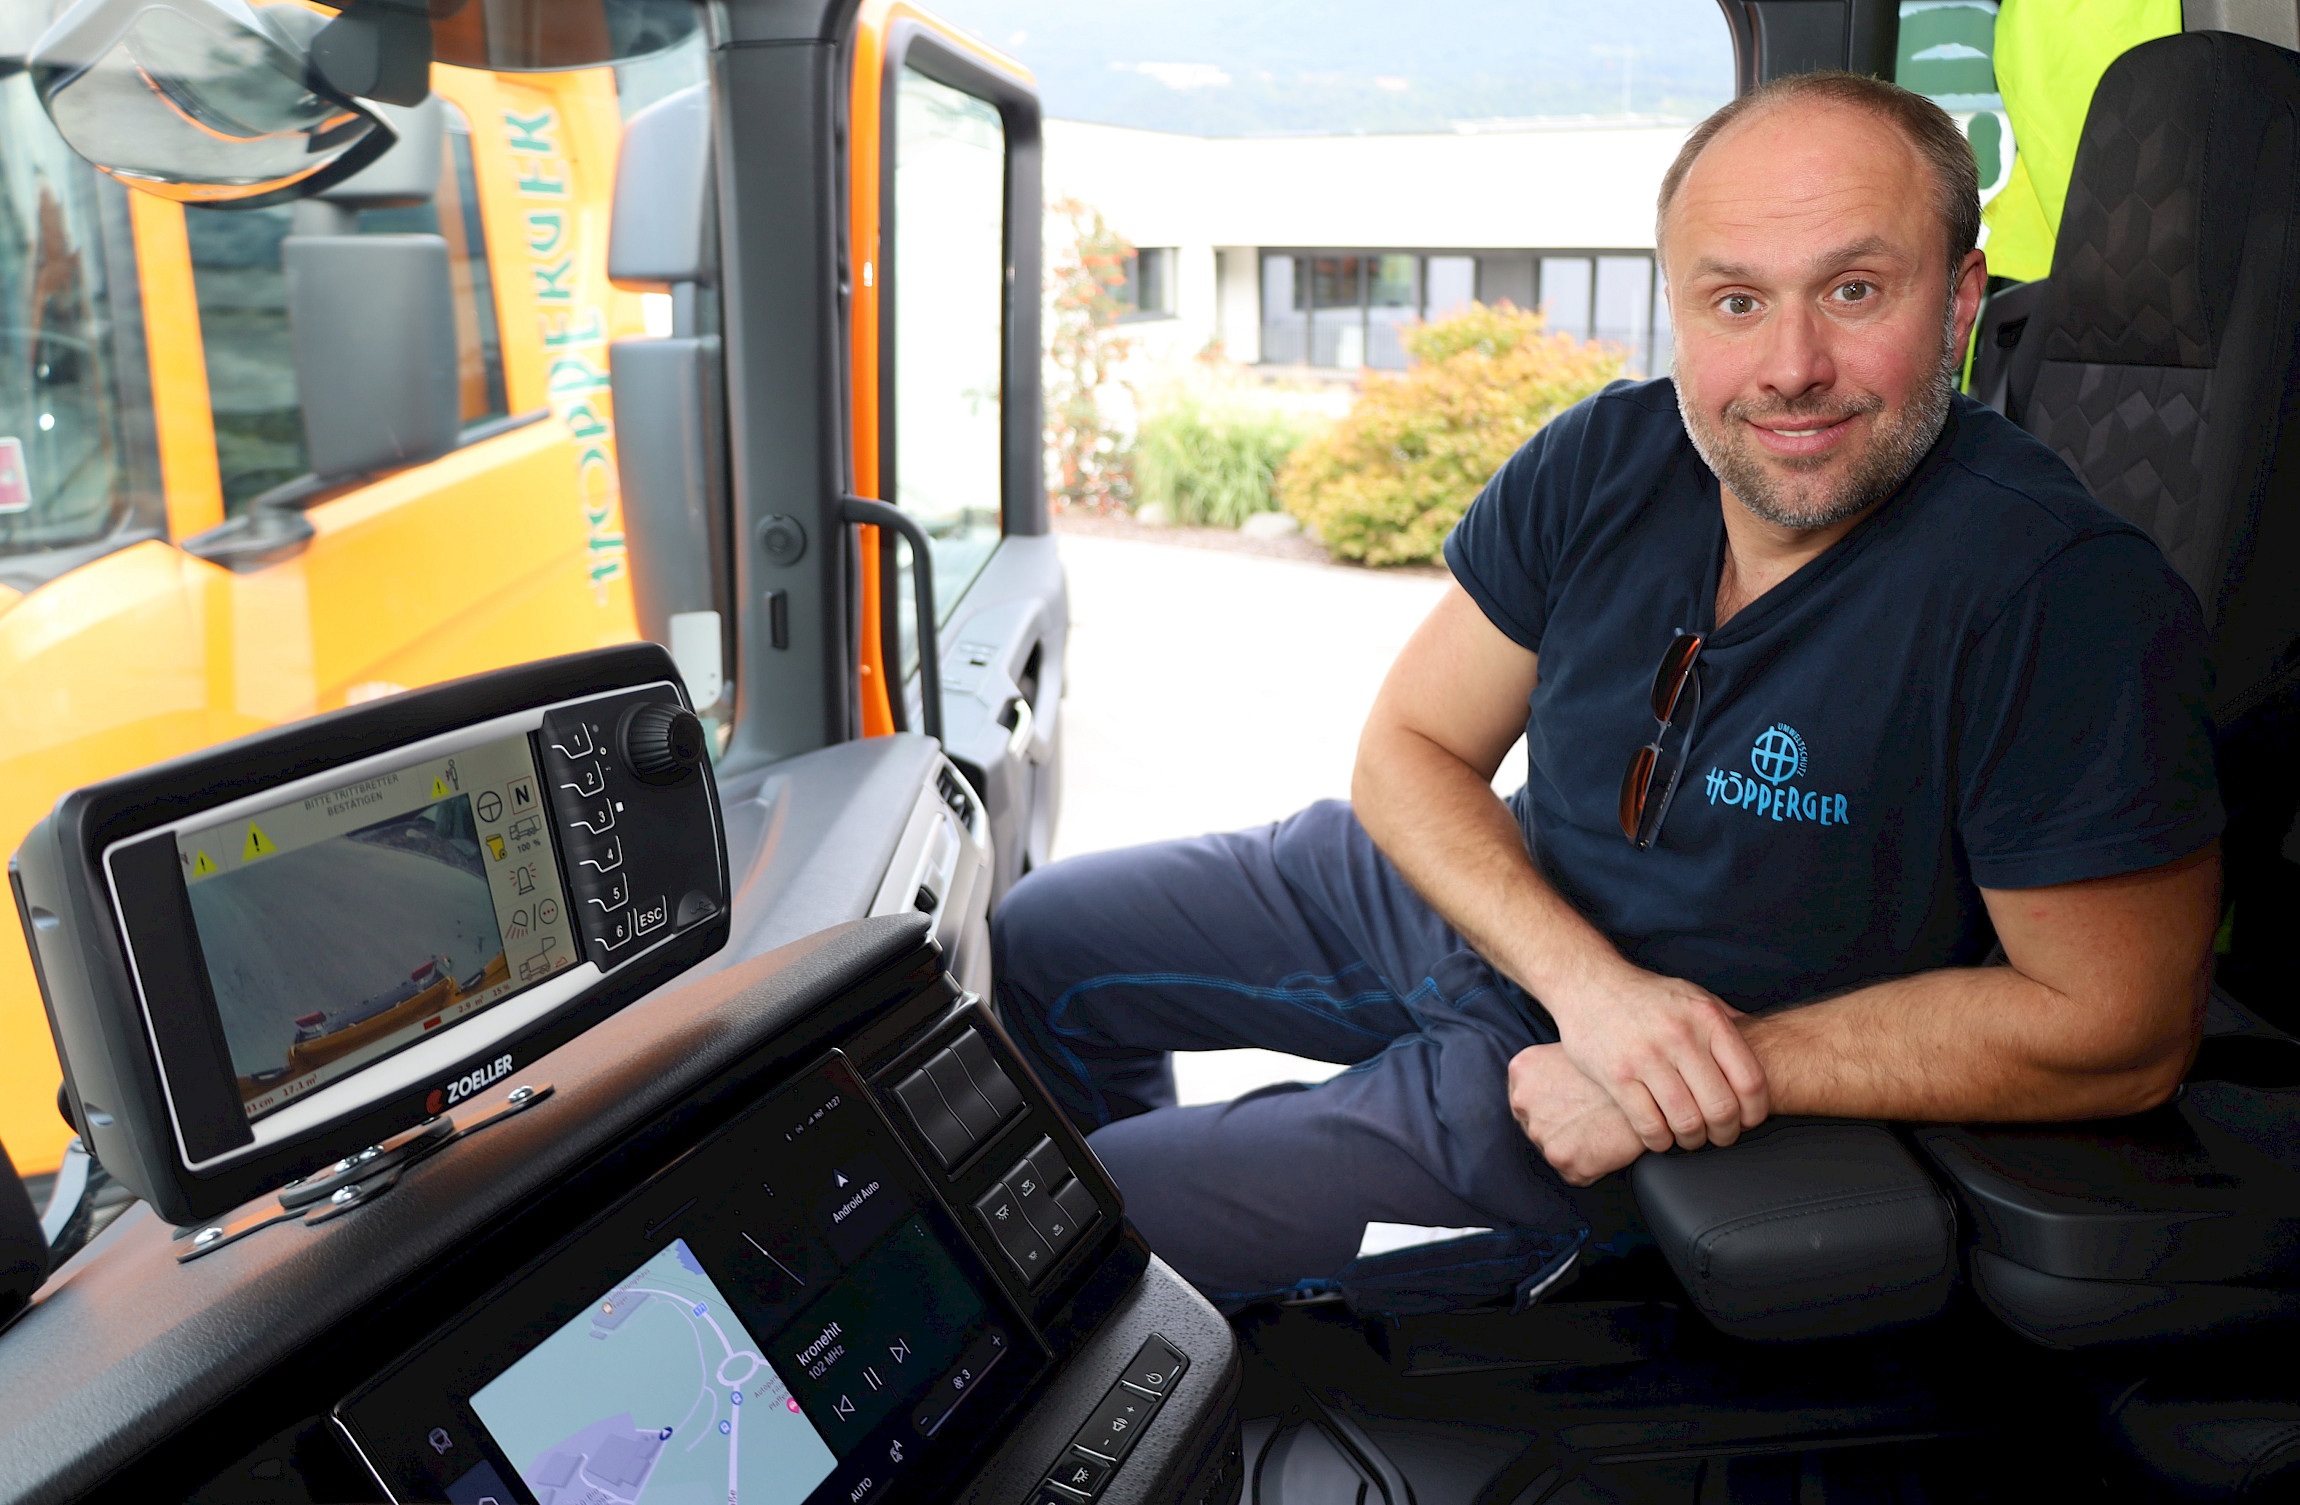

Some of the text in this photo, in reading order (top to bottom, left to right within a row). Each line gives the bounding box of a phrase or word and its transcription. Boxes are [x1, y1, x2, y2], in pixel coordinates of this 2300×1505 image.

[574, 734, 581, 747] 1
[1777, 722, 1808, 778] UMWELTSCHUTZ
[586, 772, 594, 786] 2
[304, 774, 399, 810] BITTE TRITTBRETTER
[515, 784, 530, 806] N
[598, 811, 606, 824] 3
[517, 842, 530, 854] 100
[606, 848, 614, 861] 4
[613, 887, 621, 900] 5
[639, 907, 663, 928] ESC
[616, 925, 624, 938] 6
[447, 1054, 513, 1104] ZOELLER
[260, 1096, 274, 1108] cm
[832, 1181, 879, 1223] Android Auto
[796, 1321, 842, 1366] kronehit
[808, 1345, 845, 1380] 102 MHz
[962, 1369, 971, 1380] 3
[850, 1477, 873, 1504] AUTO
